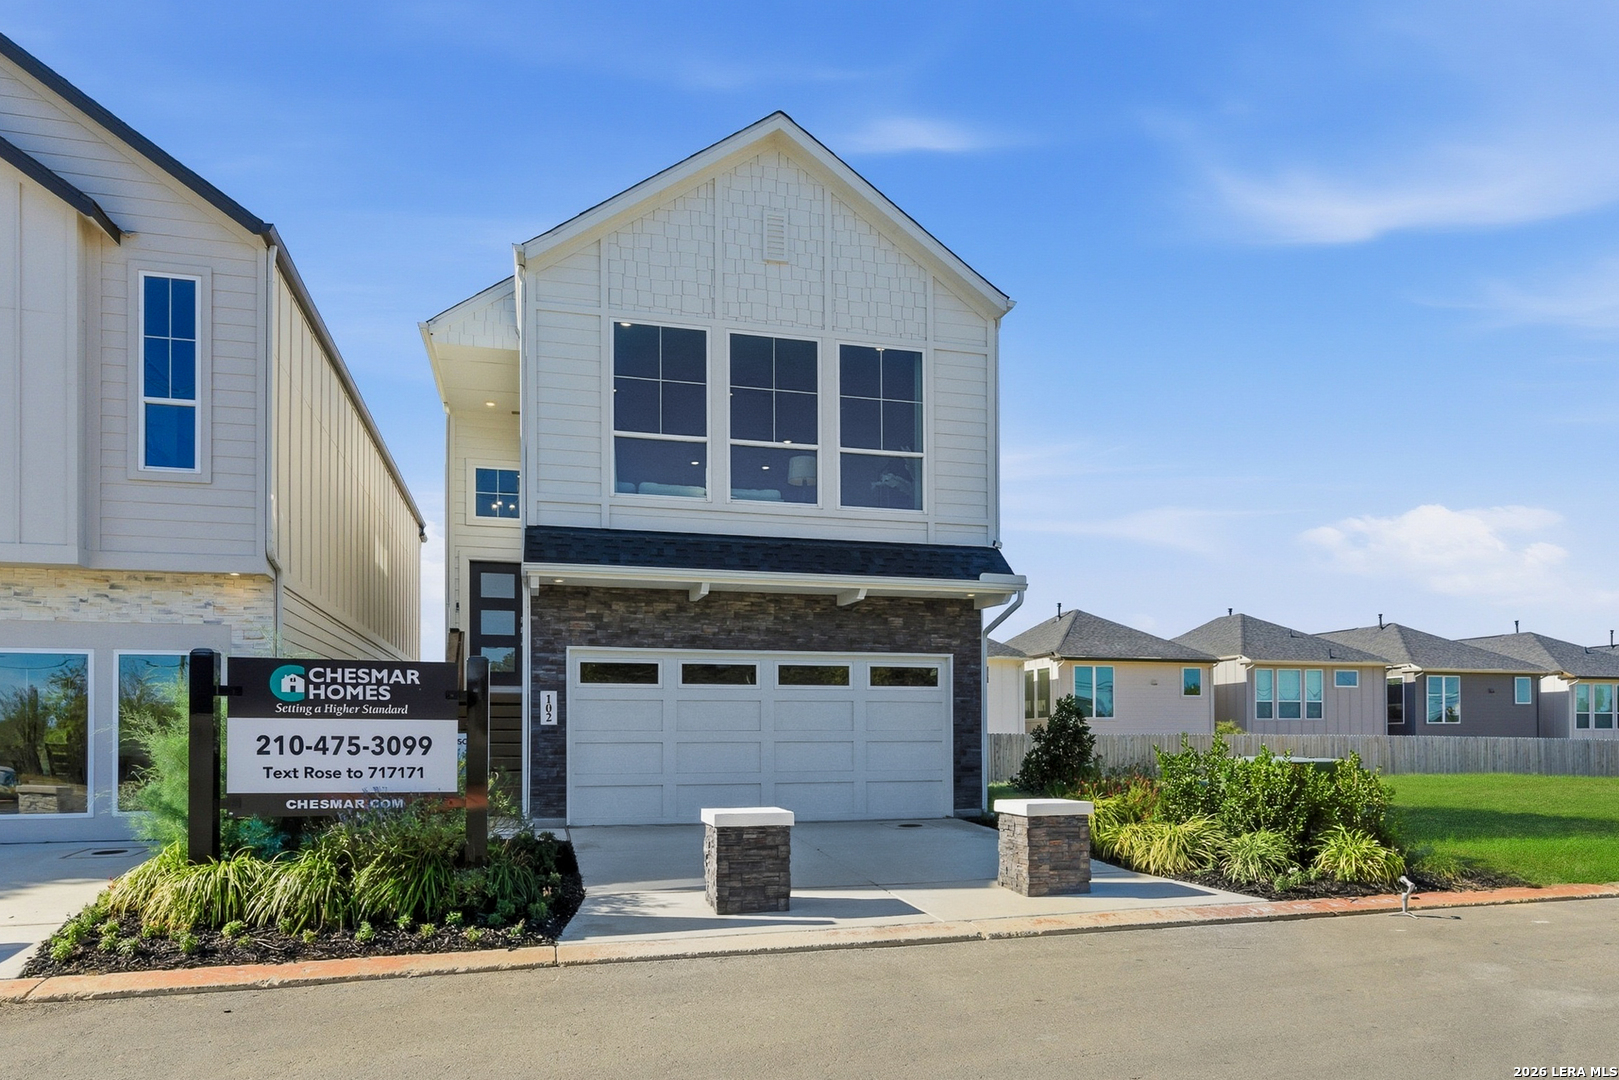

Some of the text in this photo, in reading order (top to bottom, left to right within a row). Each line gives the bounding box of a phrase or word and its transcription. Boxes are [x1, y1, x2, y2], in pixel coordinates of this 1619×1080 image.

[308, 667, 421, 685] CHESMAR
[308, 684, 391, 700] HOMES
[275, 703, 409, 716] Setting a Higher Standard
[256, 735, 433, 756] 210-475-3099
[263, 766, 424, 779] Text Rose to 717171
[285, 799, 404, 810] CHESMARCOM
